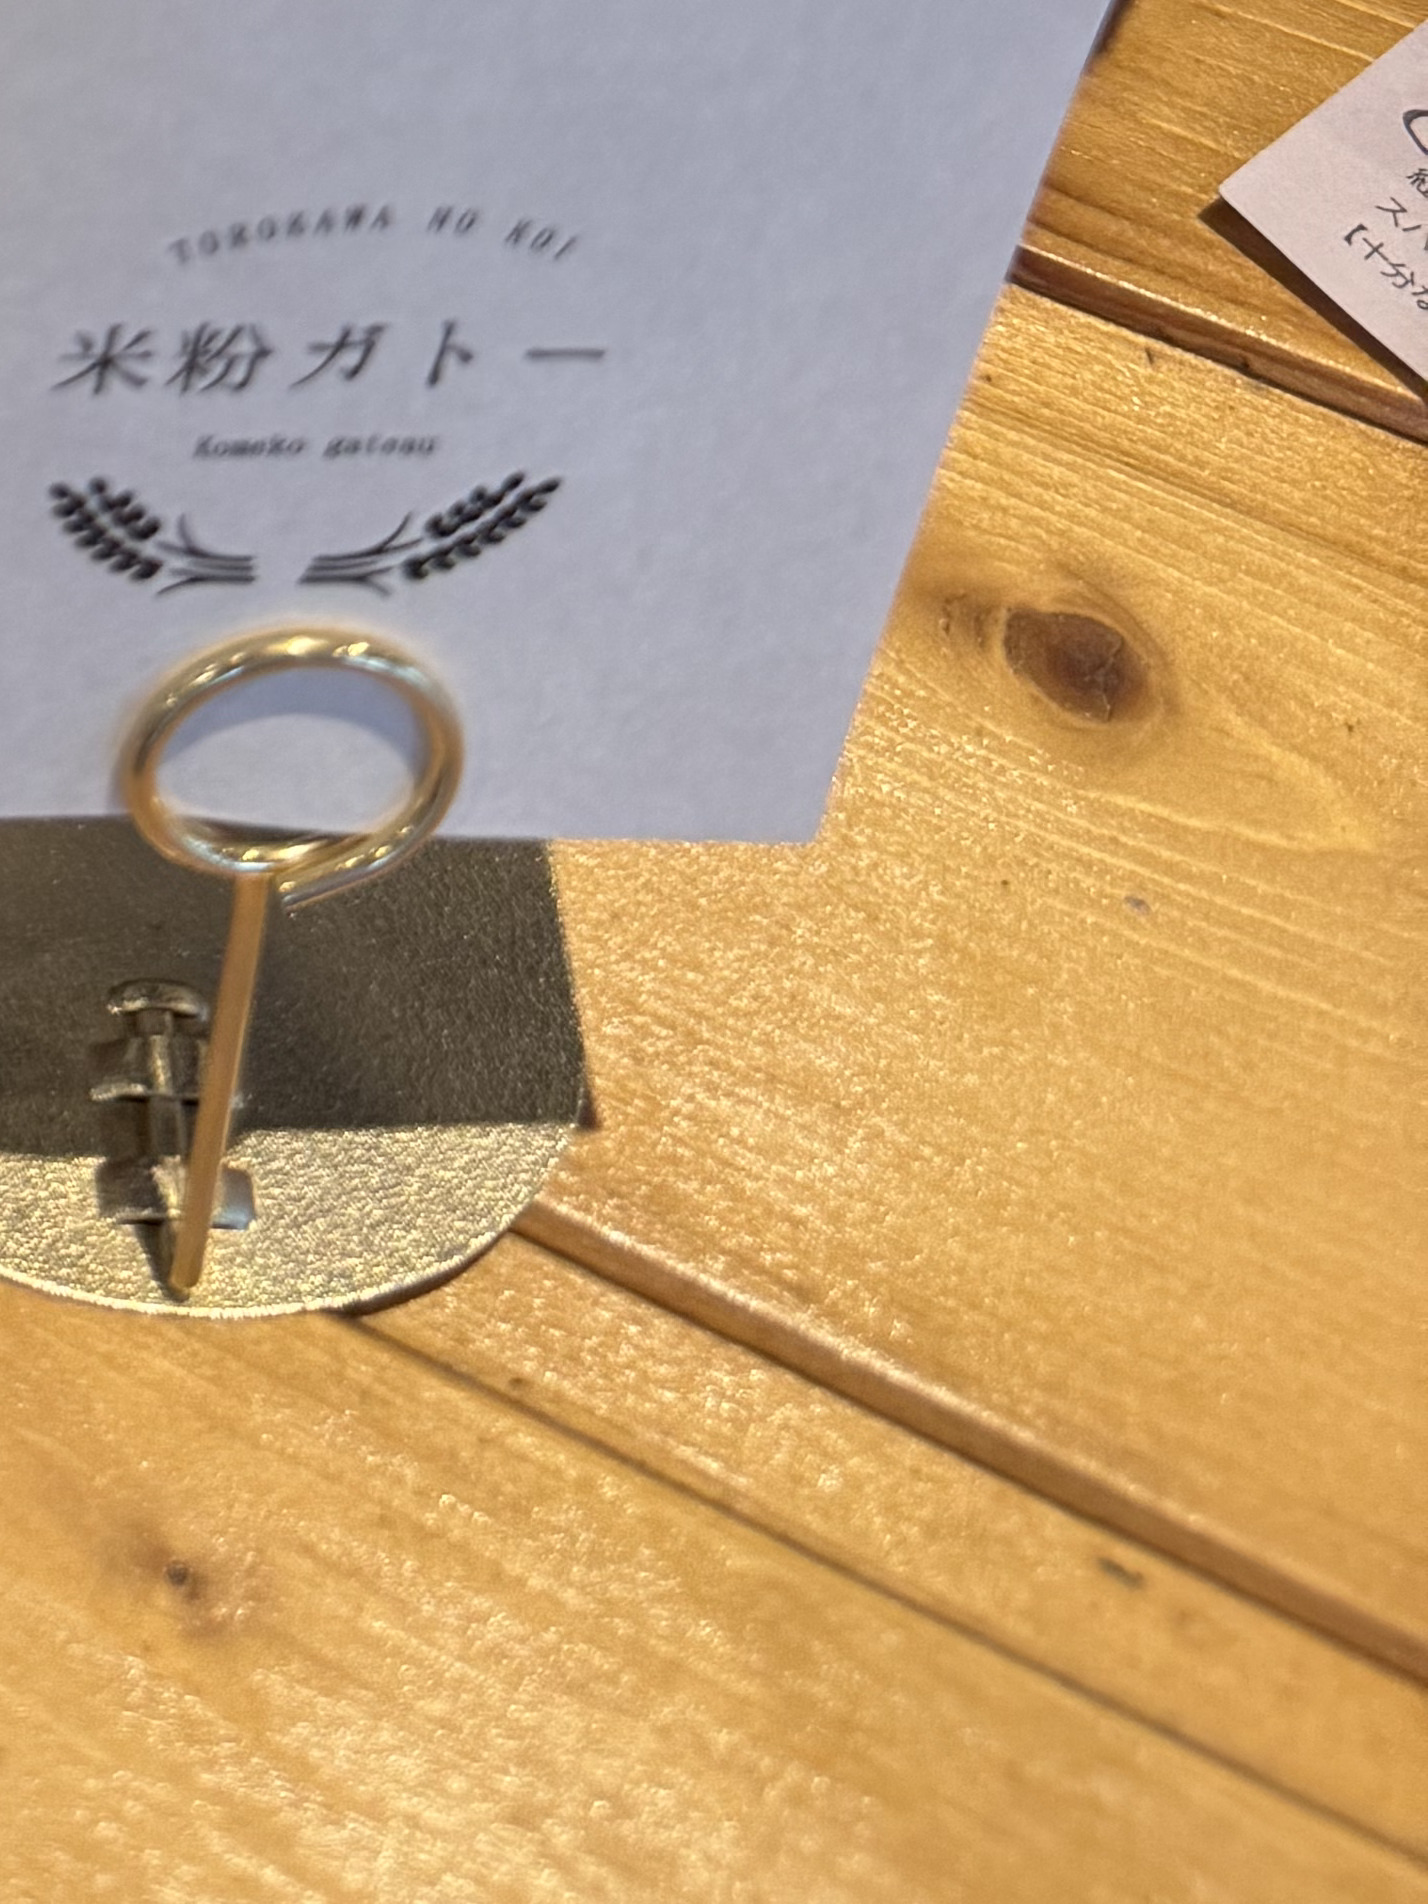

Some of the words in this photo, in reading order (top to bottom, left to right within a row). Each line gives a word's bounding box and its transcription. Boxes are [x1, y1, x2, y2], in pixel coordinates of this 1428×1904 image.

[168, 204, 394, 266] TOROKAWA
[427, 206, 480, 234] NO
[505, 219, 580, 261] KOI
[50, 318, 607, 395] 米粉ガトー
